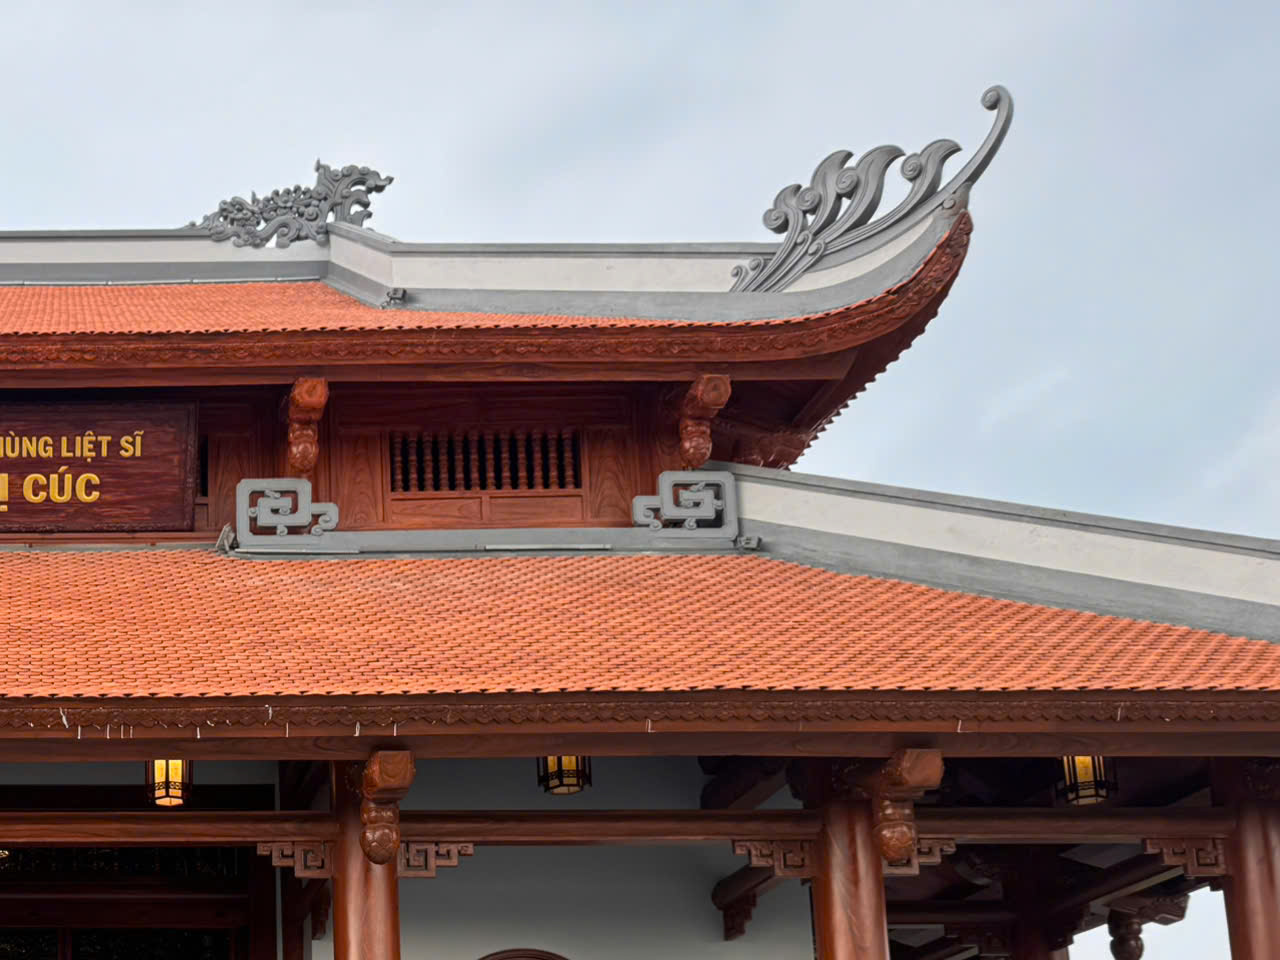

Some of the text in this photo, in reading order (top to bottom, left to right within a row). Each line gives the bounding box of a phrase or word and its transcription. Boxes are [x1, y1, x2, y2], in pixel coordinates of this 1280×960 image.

[60, 431, 112, 463] LIỆT
[119, 430, 145, 458] SĨ
[22, 465, 101, 503] CÚC
